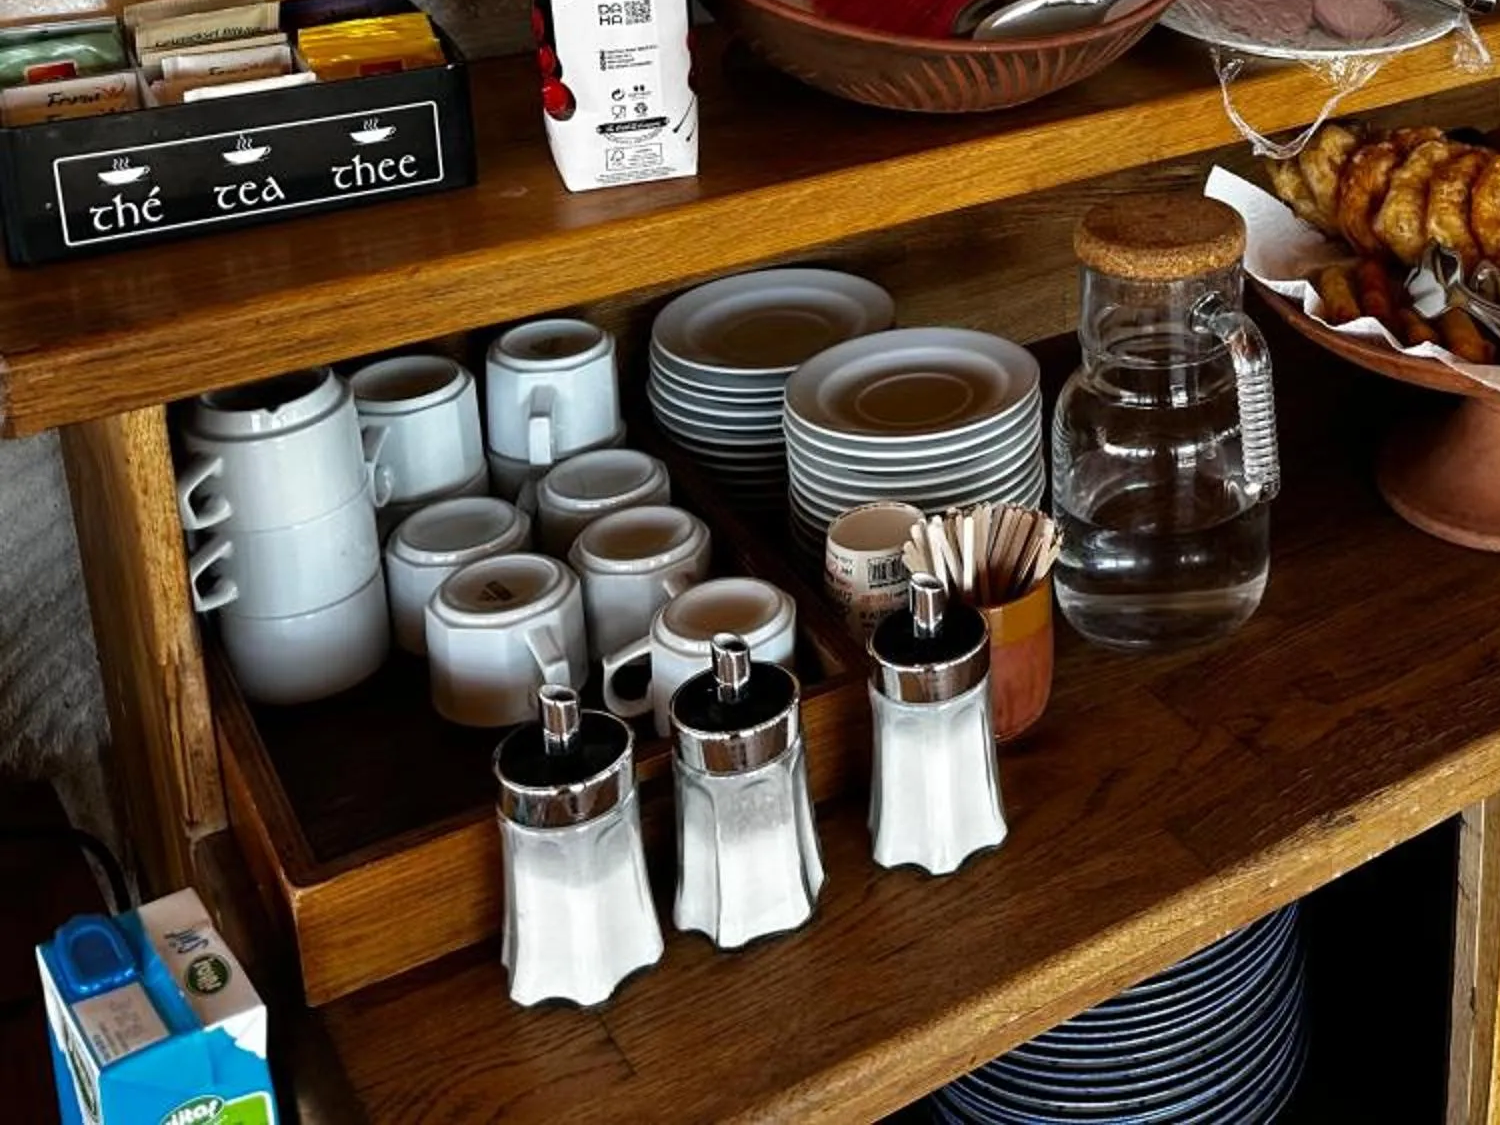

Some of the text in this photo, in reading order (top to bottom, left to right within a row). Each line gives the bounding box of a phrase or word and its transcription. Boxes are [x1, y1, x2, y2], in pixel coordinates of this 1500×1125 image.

[89, 153, 418, 231] thé tea thee
